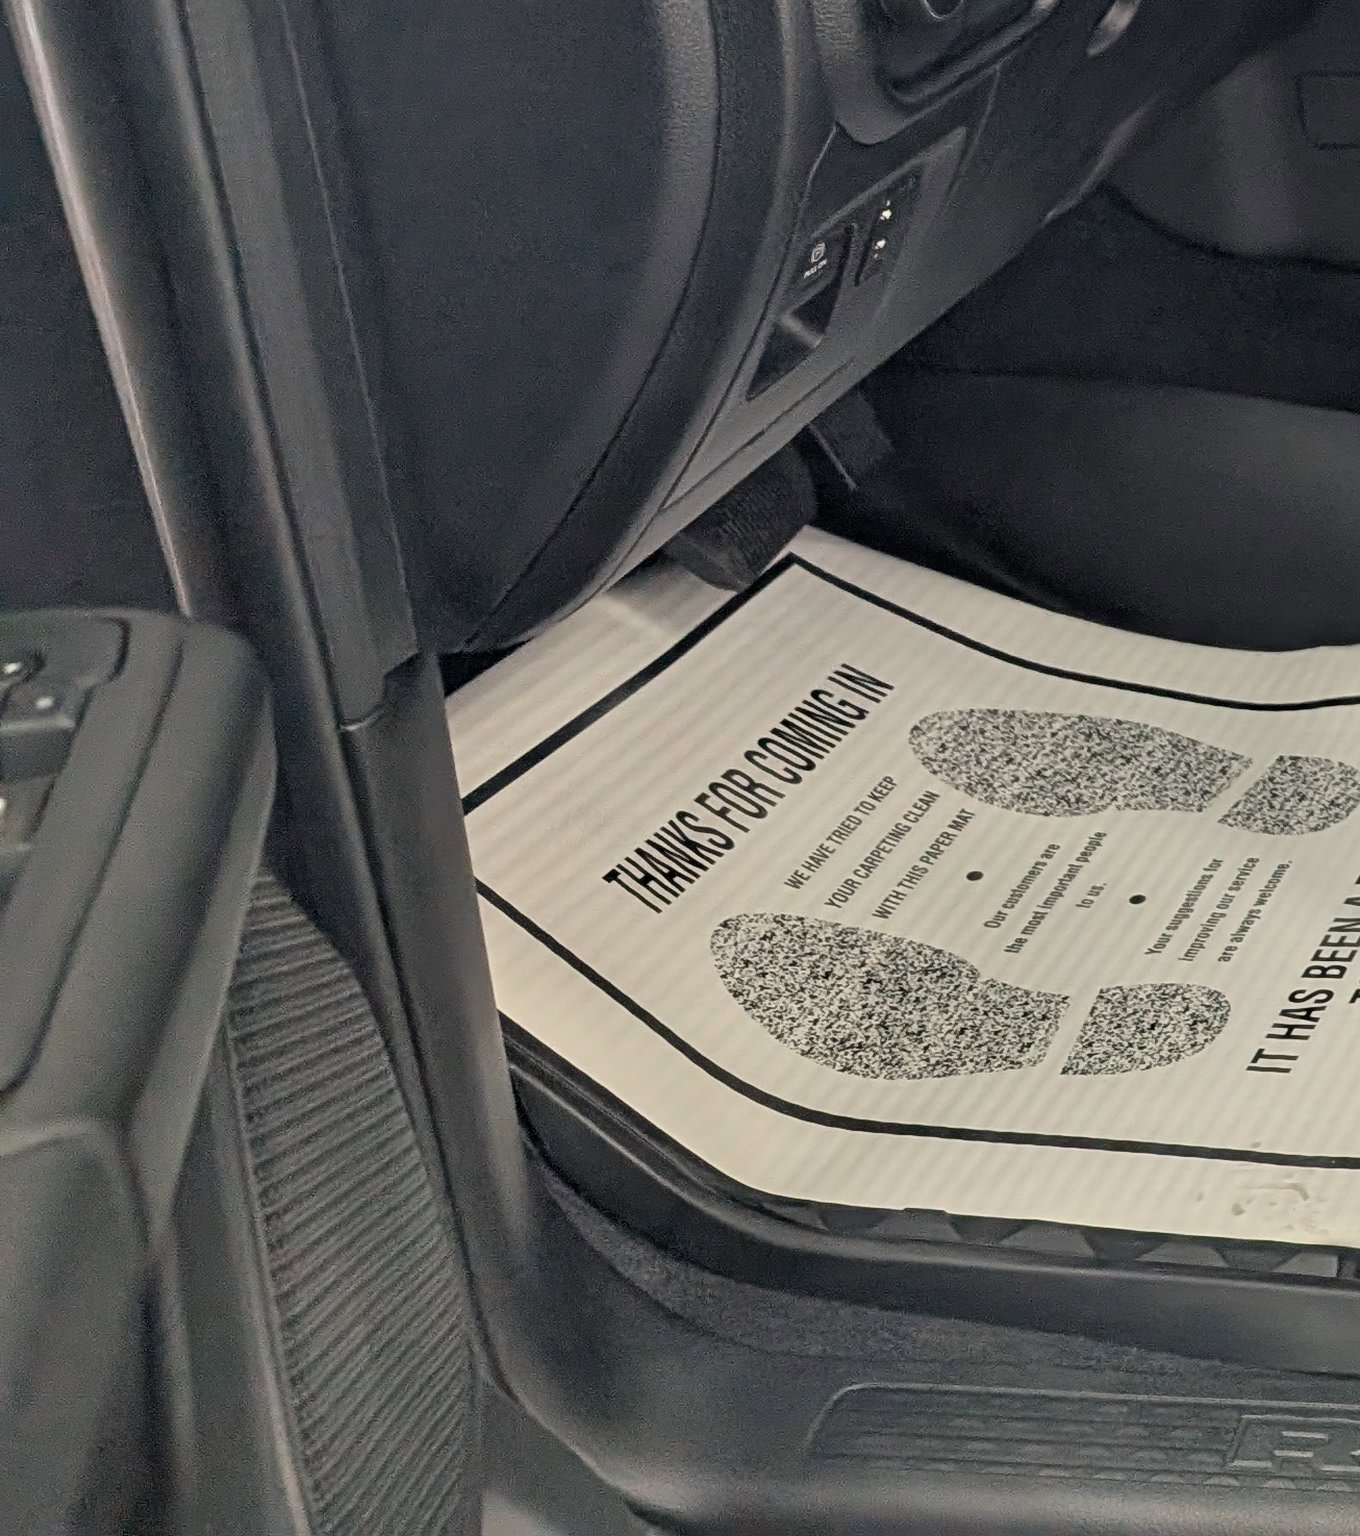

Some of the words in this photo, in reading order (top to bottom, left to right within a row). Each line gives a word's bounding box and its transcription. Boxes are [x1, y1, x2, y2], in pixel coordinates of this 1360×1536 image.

[602, 810, 735, 914] THANKS
[694, 768, 786, 833] FOR
[744, 689, 870, 784] COMING
[827, 663, 895, 704] IN
[784, 870, 811, 890] WE
[801, 843, 837, 873] HAVE
[826, 815, 863, 845] TRIED
[854, 800, 876, 816] TO
[867, 775, 898, 803] KEEP
[824, 878, 863, 909] YOUR
[853, 822, 912, 880] CARPETING
[903, 790, 941, 824] CLEAN
[872, 889, 908, 920] WITH
[897, 864, 929, 891] THIS
[919, 830, 958, 866] PAPER
[948, 807, 976, 832] MAT
[983, 910, 1008, 929] Our
[1002, 861, 1048, 909] customers
[1041, 844, 1060, 860] are
[1004, 937, 1028, 954] the
[1021, 910, 1048, 935] most
[1037, 864, 1083, 910] important
[1075, 831, 1107, 863] people
[1076, 898, 1094, 909] to
[1087, 882, 1108, 897] us.
[1144, 933, 1173, 956] Your
[1165, 874, 1214, 931] suggestions
[1203, 858, 1224, 873] for
[1178, 911, 1227, 962] improving
[1216, 893, 1236, 910] our
[1228, 857, 1260, 892] service
[1217, 945, 1239, 963] are
[1230, 908, 1262, 943] always
[1253, 860, 1293, 907] welcome.
[1246, 1048, 1299, 1074] IT
[1265, 989, 1334, 1041] HAS
